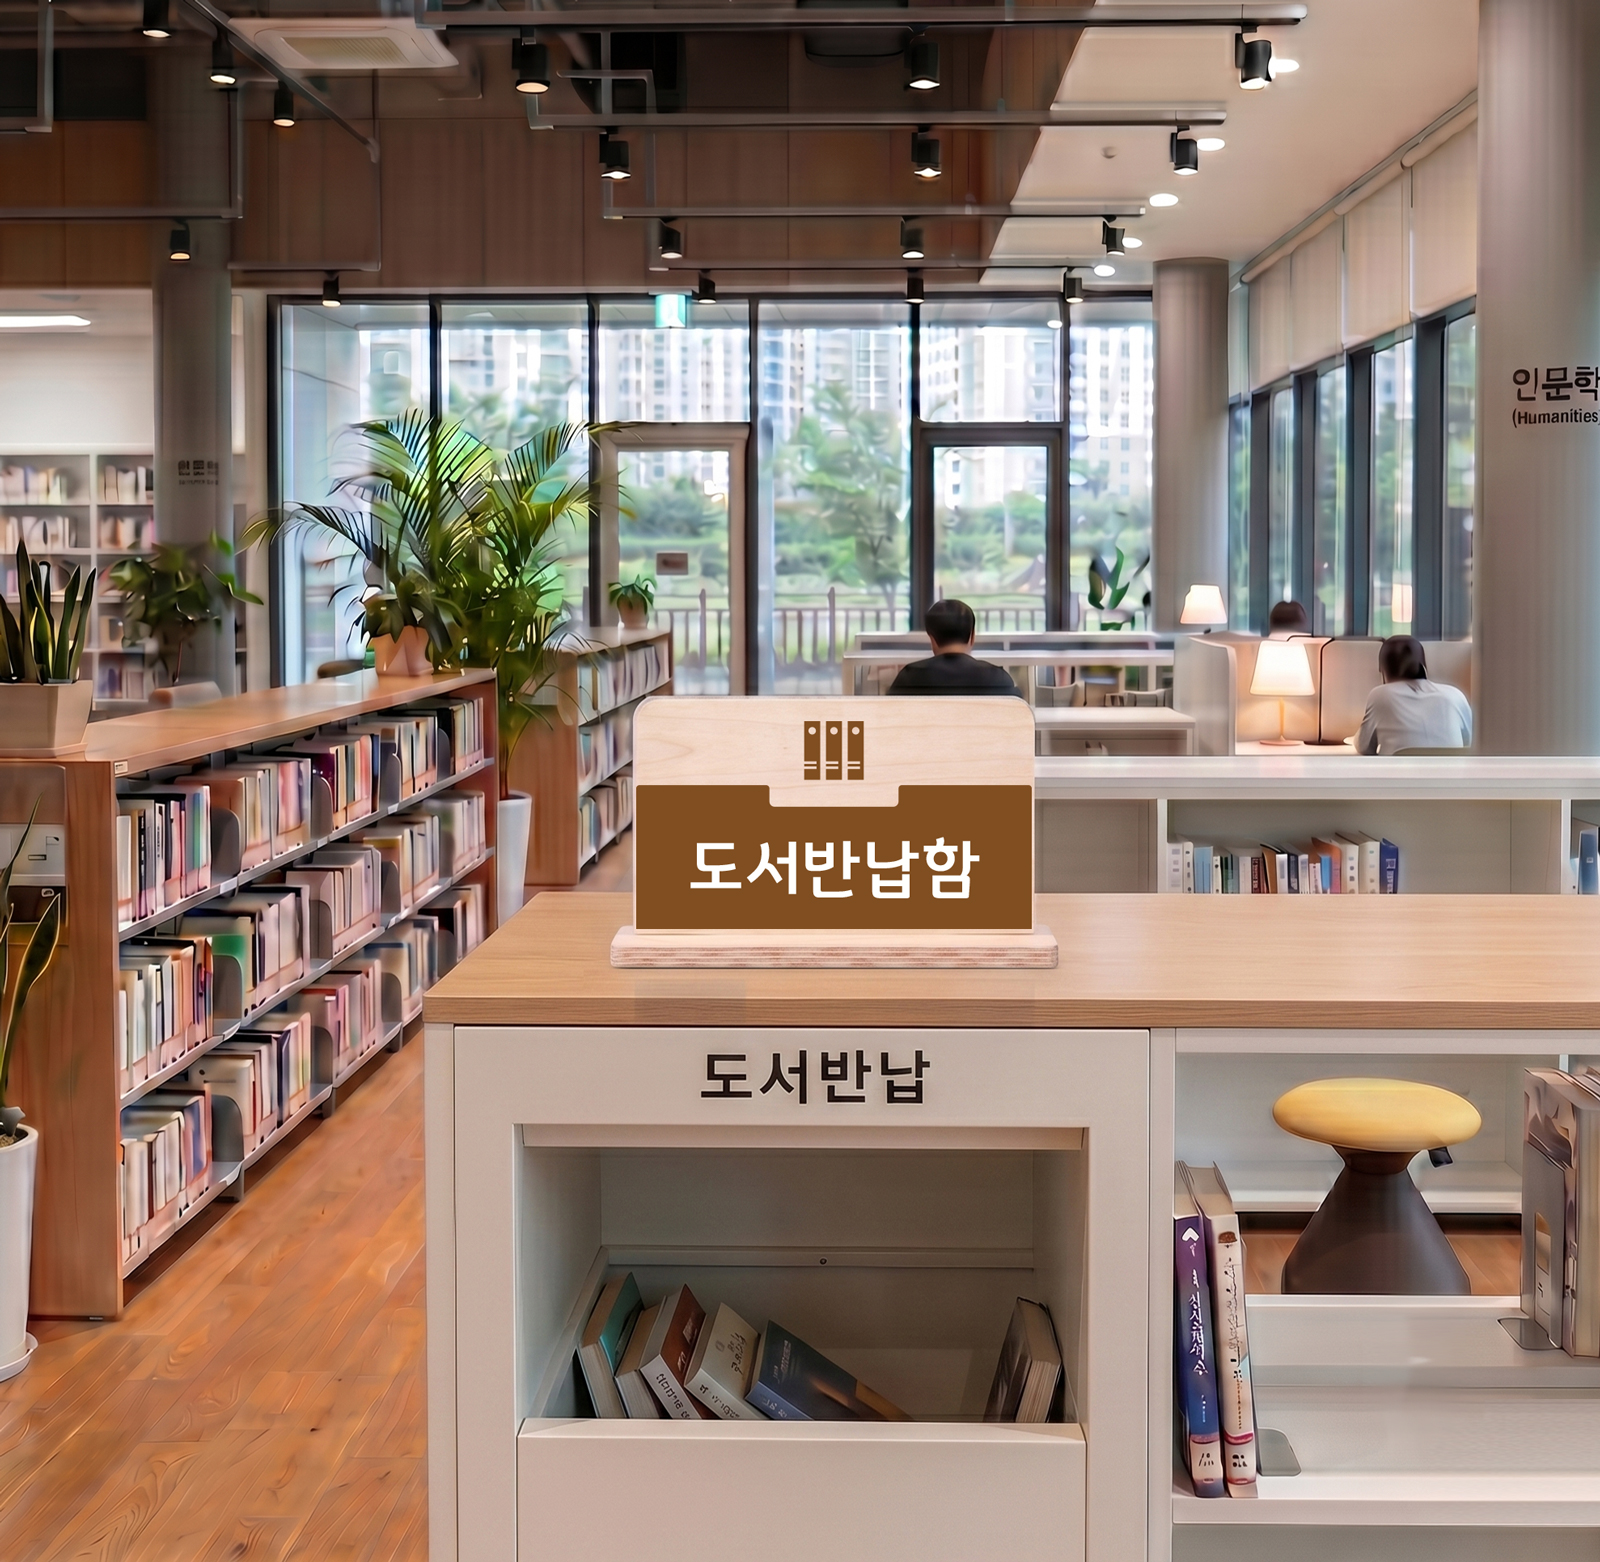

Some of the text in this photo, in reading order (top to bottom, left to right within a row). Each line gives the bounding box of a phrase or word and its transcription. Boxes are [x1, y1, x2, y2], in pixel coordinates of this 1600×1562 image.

[1513, 367, 1600, 401] 인문학
[691, 837, 979, 898] 도서반납함
[701, 1050, 930, 1104] 도서반납
